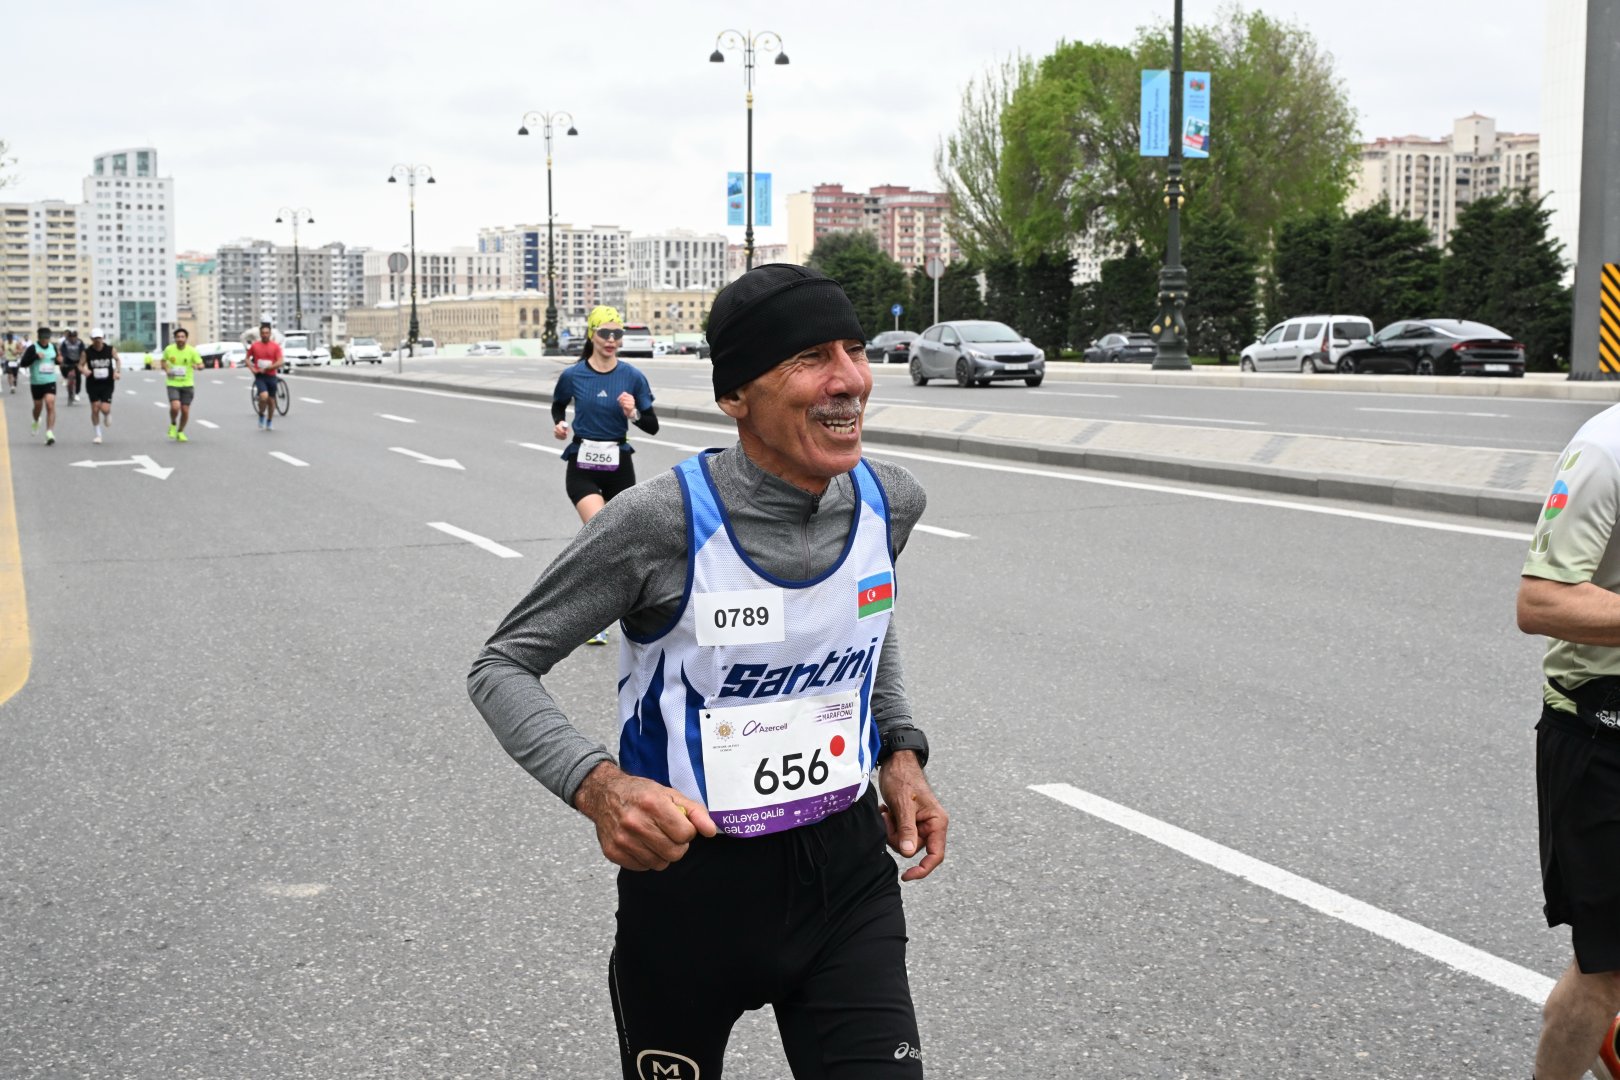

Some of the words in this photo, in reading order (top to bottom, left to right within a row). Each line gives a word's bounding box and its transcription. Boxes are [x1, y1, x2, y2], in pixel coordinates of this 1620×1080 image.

[585, 452, 612, 463] 5256
[713, 606, 770, 629] 0789
[718, 636, 879, 699] Santini
[822, 709, 853, 721] MARAFONU
[759, 722, 788, 734] Azercell
[753, 748, 829, 796] 656
[722, 813, 760, 825] KÜLƏYƏ
[760, 807, 785, 821] QALİB
[724, 826, 744, 834] GƏL
[744, 823, 766, 834] 2026
